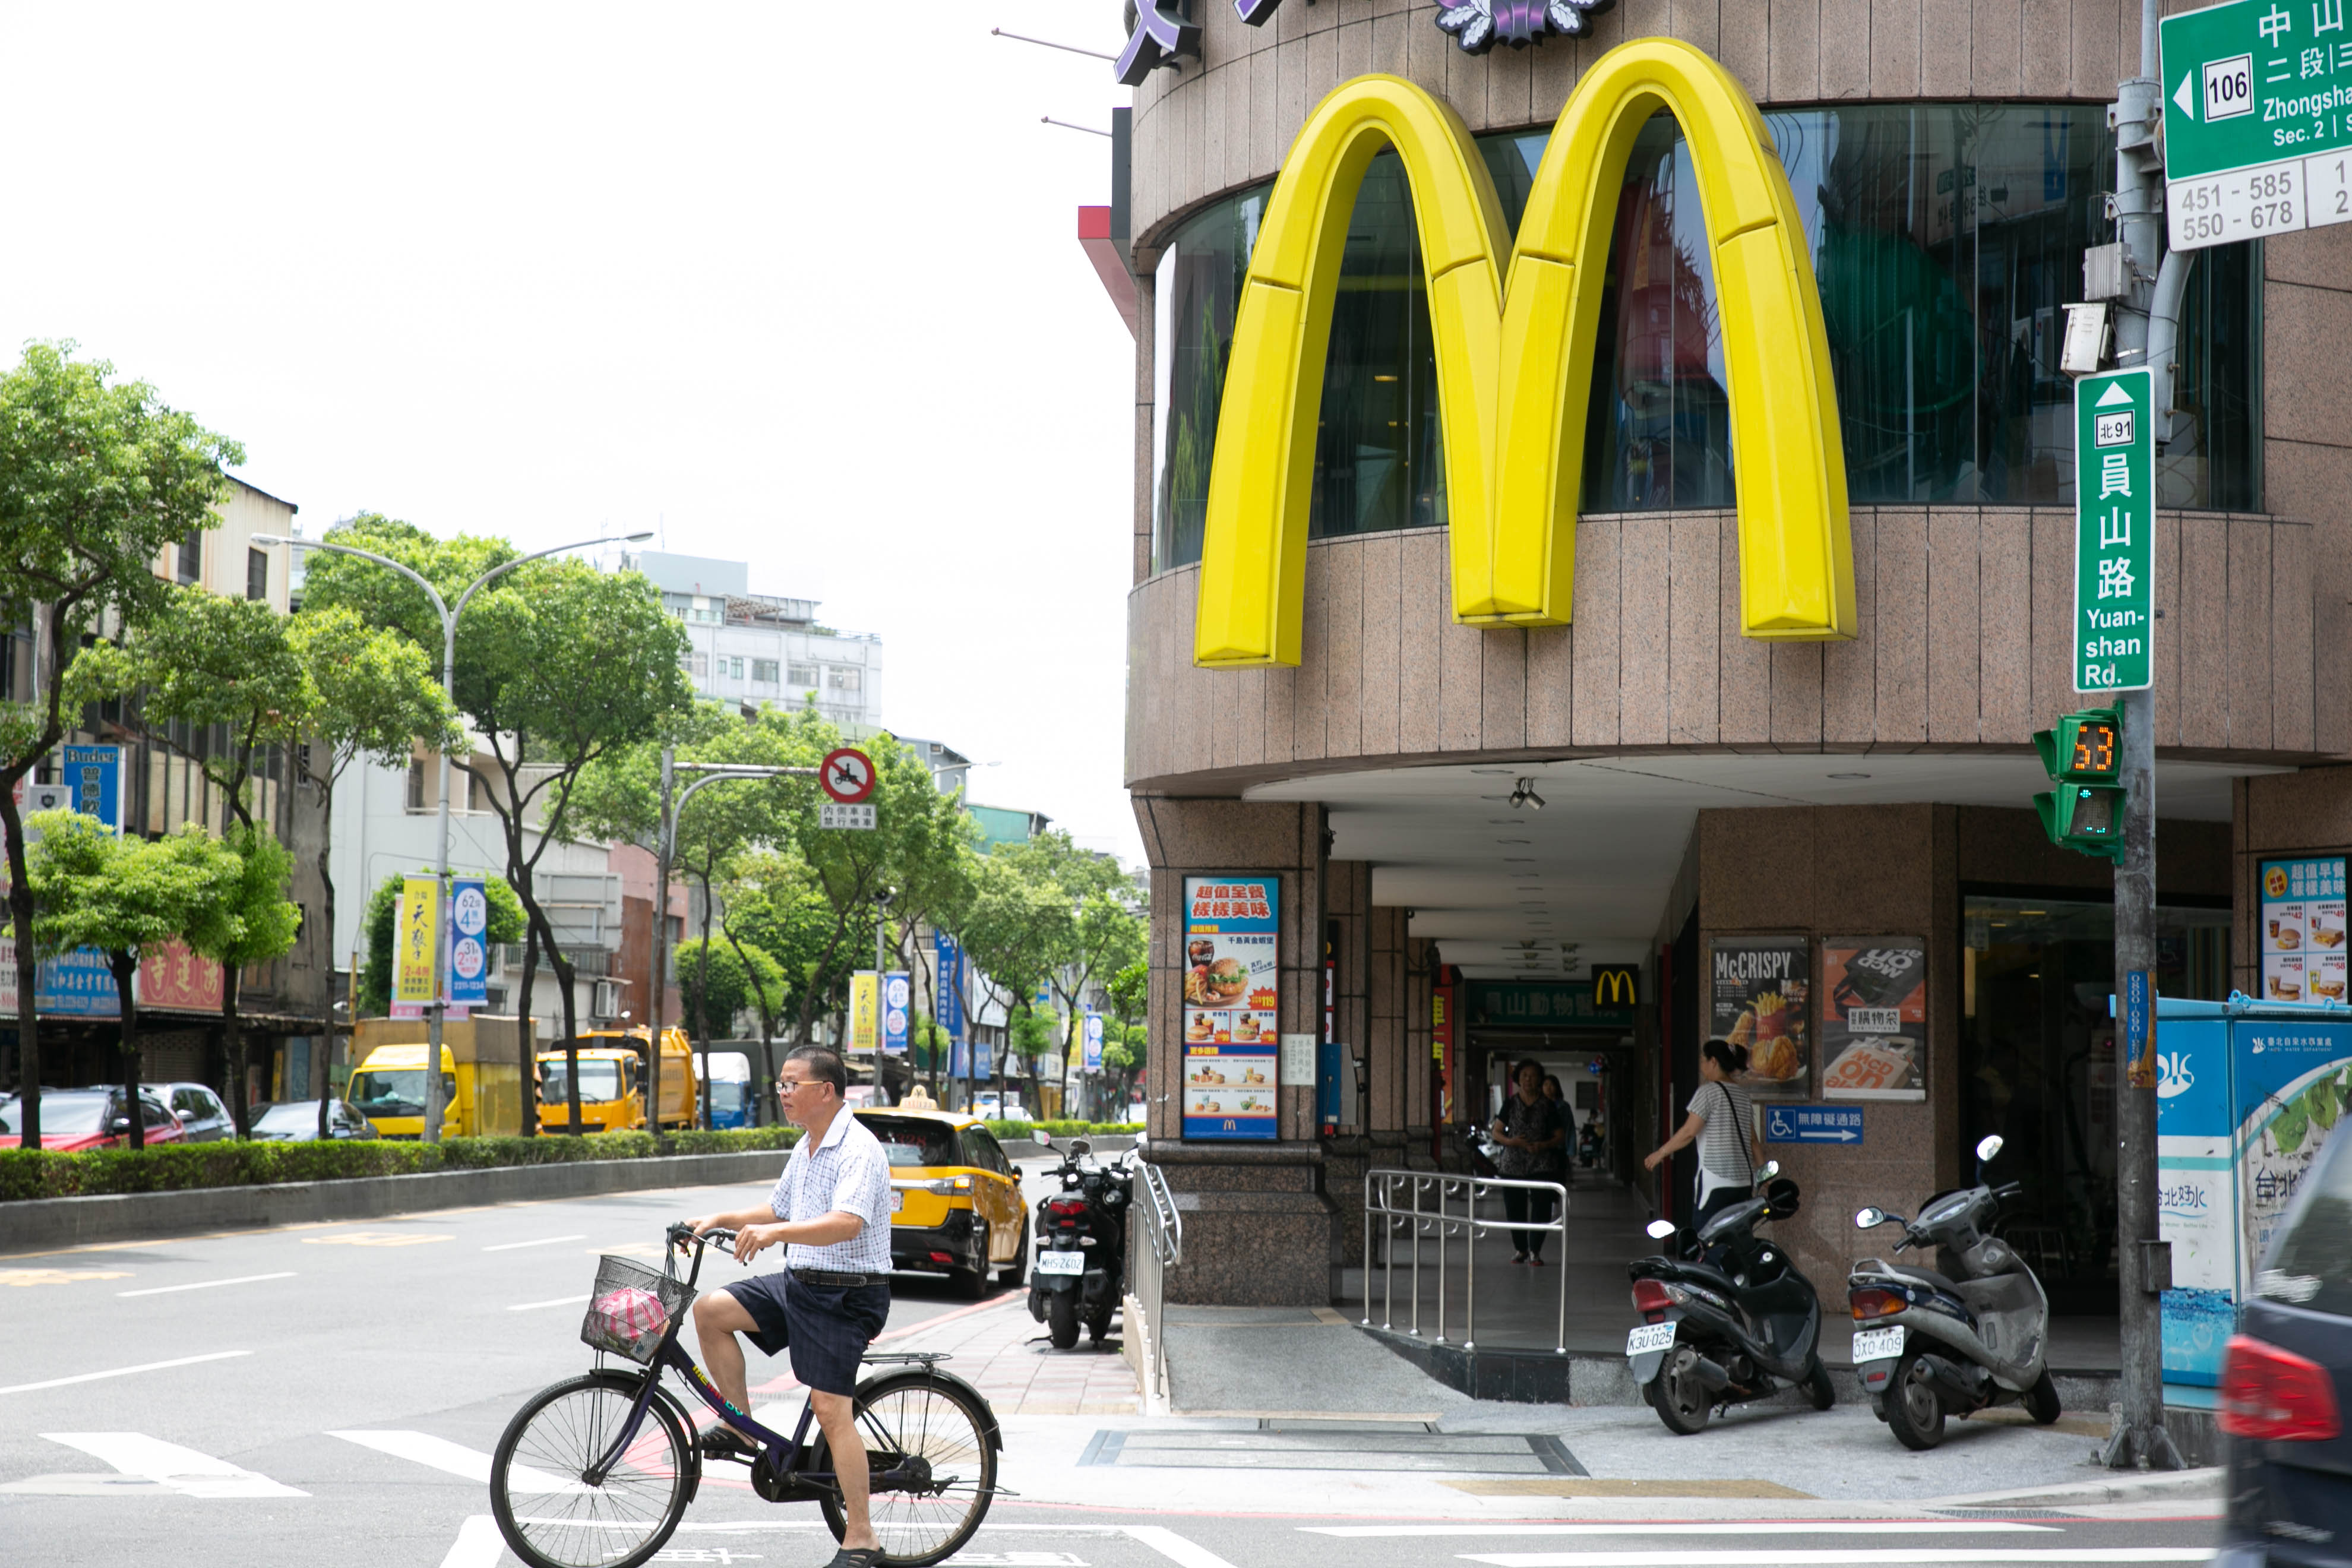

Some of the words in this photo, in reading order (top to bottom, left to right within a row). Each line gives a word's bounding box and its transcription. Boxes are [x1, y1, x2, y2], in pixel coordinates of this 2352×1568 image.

[2209, 72, 2247, 104] 106
[2274, 128, 2310, 147] Sec.
[2315, 121, 2323, 138] 2
[2182, 184, 2221, 212] 451
[2250, 171, 2292, 200] 585
[2183, 213, 2224, 241] 550
[2251, 201, 2293, 230] 678
[2100, 420, 2131, 439] 北91
[2098, 453, 2135, 599] 員山路
[2087, 608, 2144, 630] Yuan-
[2086, 636, 2141, 657] shan
[2085, 662, 2122, 686] Rd.
[67, 749, 117, 763] Buder
[2075, 726, 2113, 770] 53
[824, 806, 871, 816] 內側車道
[1195, 884, 1266, 899] 超值全餐
[1716, 951, 1791, 979] McCRISPY
[1262, 995, 1275, 1007] 119
[1858, 1010, 1897, 1026] 購物袋
[1798, 1112, 1861, 1126] 無障礙通路
